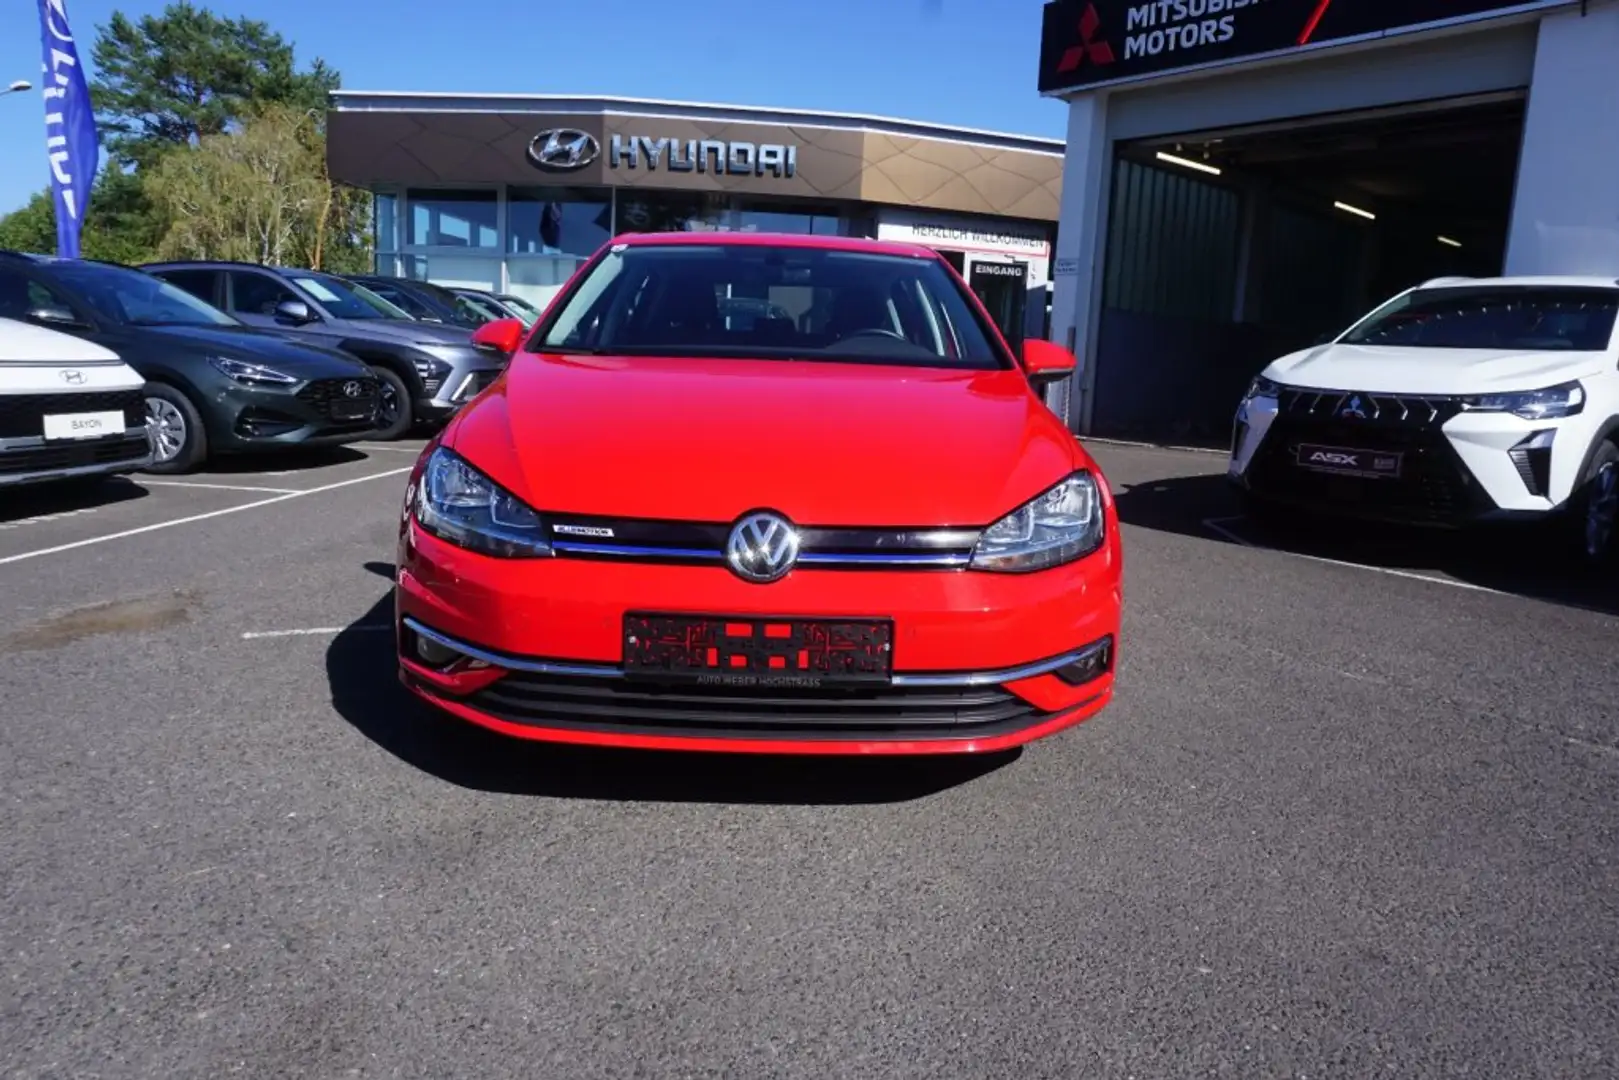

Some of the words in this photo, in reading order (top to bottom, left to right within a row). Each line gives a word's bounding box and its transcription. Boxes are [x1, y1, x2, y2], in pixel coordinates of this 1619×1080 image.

[1124, 15, 1235, 60] MOTORS
[610, 133, 798, 178] HYUNDAI
[911, 223, 968, 240] HERZLICH
[971, 231, 1044, 249] WILLKOMMEN
[975, 264, 1022, 277] EINGANG
[71, 419, 102, 430] BAYON
[1309, 451, 1359, 466] ASX
[697, 675, 721, 685] AUTO
[723, 676, 757, 686] WEBER
